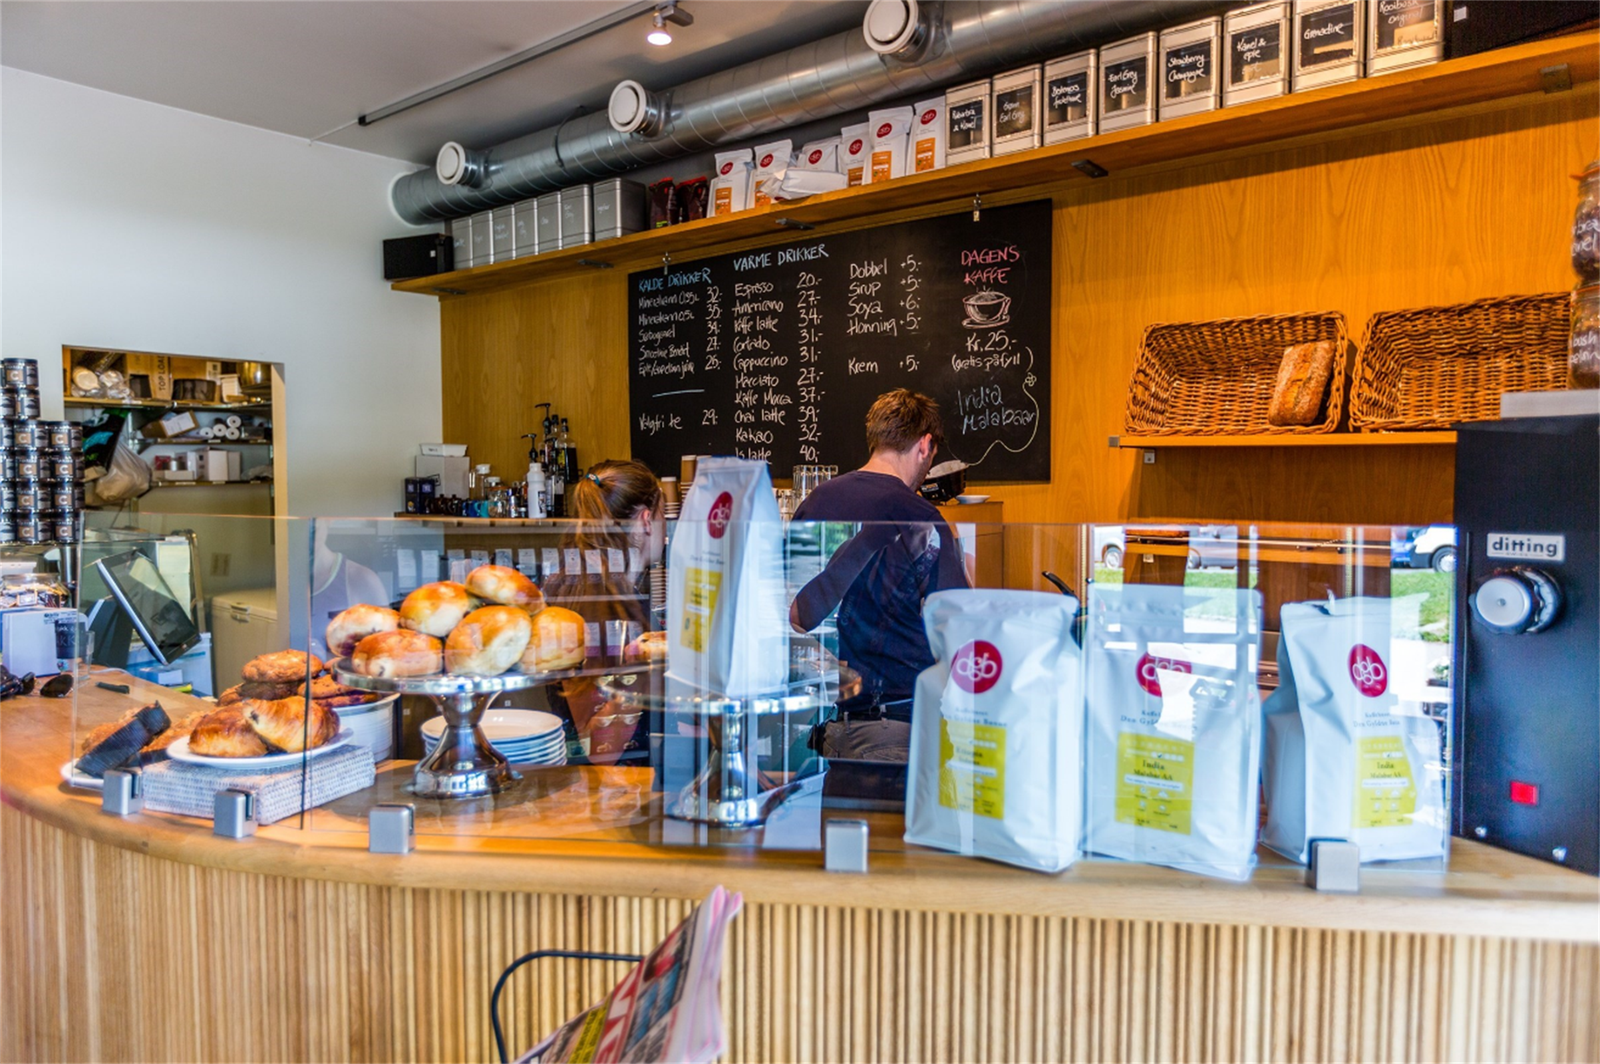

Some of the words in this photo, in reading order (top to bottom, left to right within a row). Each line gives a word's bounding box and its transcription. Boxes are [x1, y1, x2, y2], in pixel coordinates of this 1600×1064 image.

[733, 252, 772, 272] VARME
[777, 243, 829, 266] DRIKKER
[961, 244, 1020, 267] DAGENS
[849, 258, 888, 279] Dobbel
[963, 266, 1011, 286] KAFFE
[638, 277, 664, 292] KALDE
[667, 267, 712, 287] DRIKKER
[848, 281, 881, 297] Sirup
[731, 298, 784, 317] Americano
[847, 297, 883, 319] Soya
[756, 314, 779, 333] latte
[847, 316, 898, 337] Honning
[733, 335, 770, 356] Cortado
[733, 352, 788, 373] Cappuccino
[848, 357, 878, 375] Krem
[957, 384, 1004, 416] India
[668, 412, 683, 430] te
[734, 409, 755, 423] Chai
[761, 406, 786, 426] latte
[735, 426, 774, 444] Kakao
[1492, 536, 1557, 558] ditting
[1142, 759, 1165, 770] India
[1376, 761, 1395, 769] India
